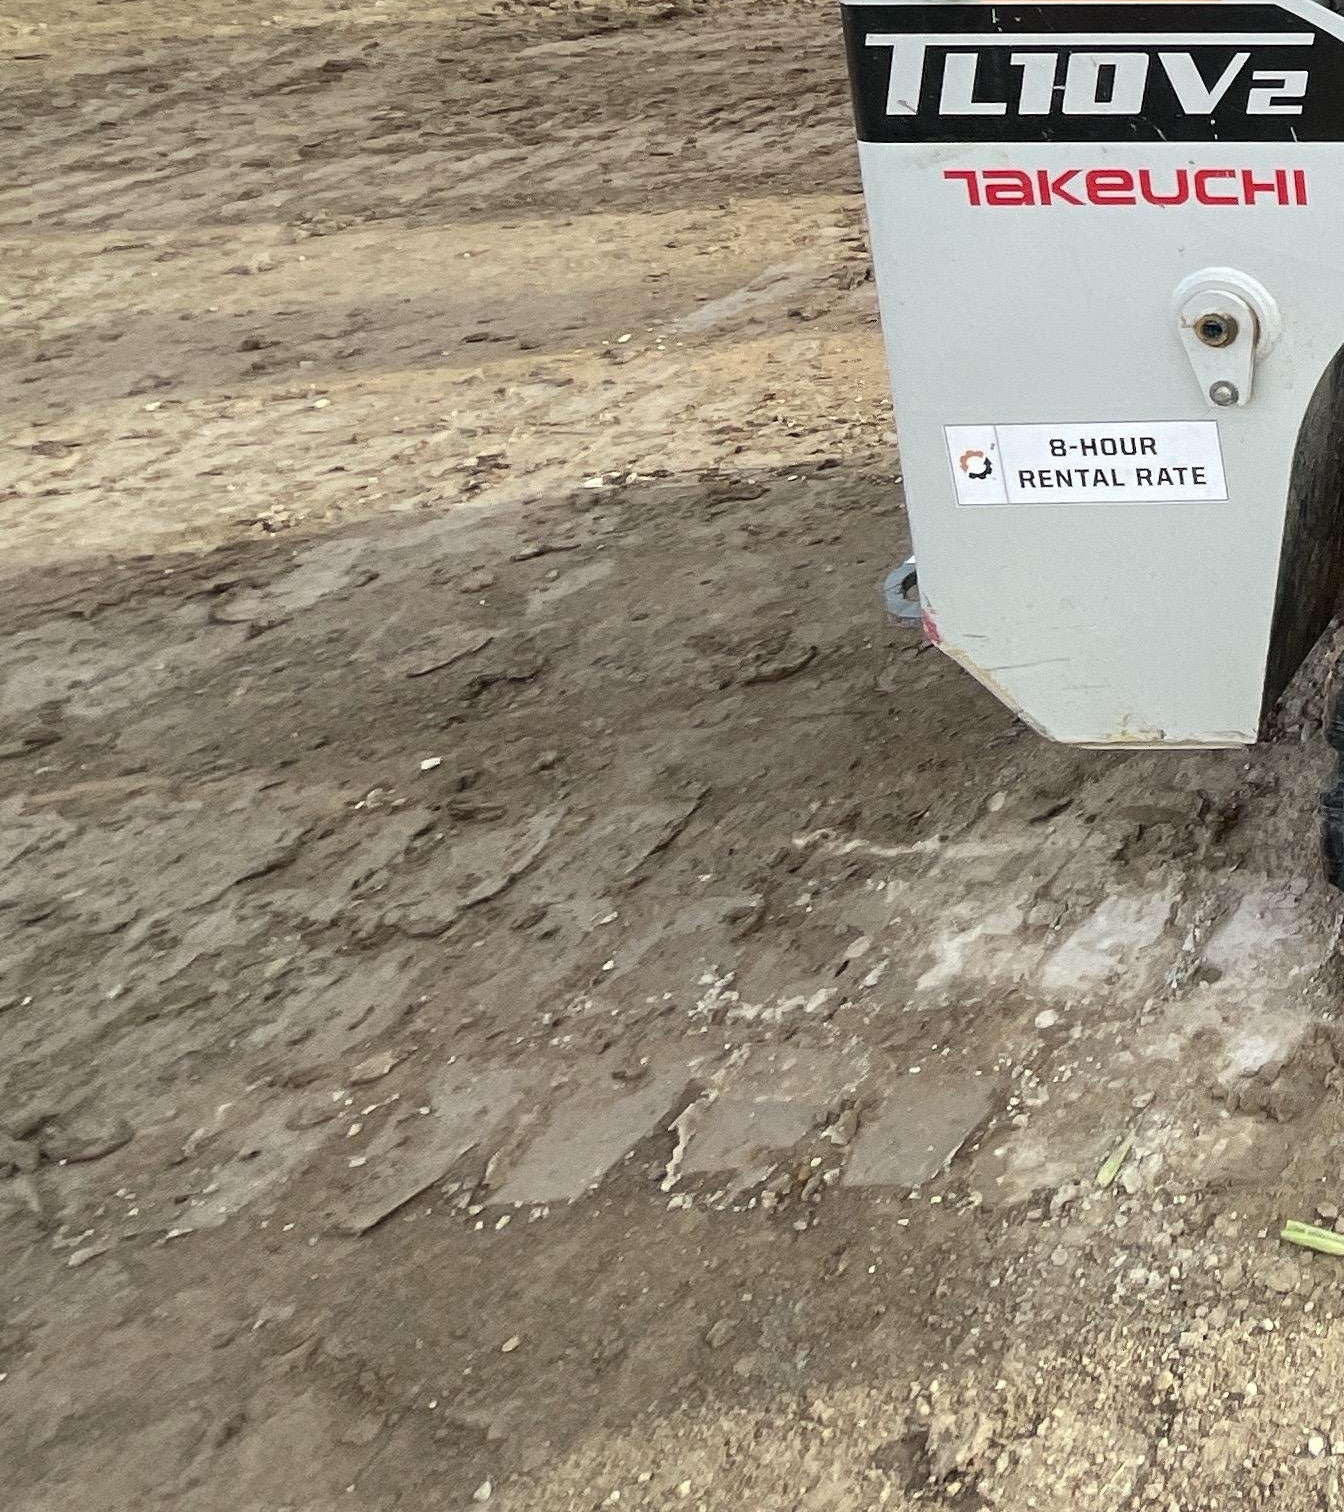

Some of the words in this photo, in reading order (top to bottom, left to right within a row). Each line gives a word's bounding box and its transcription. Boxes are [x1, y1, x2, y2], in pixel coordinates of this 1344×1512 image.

[1049, 436, 1159, 458] 8-HOUR
[1018, 467, 1126, 489] RENTAL
[1135, 466, 1208, 487] RATE
